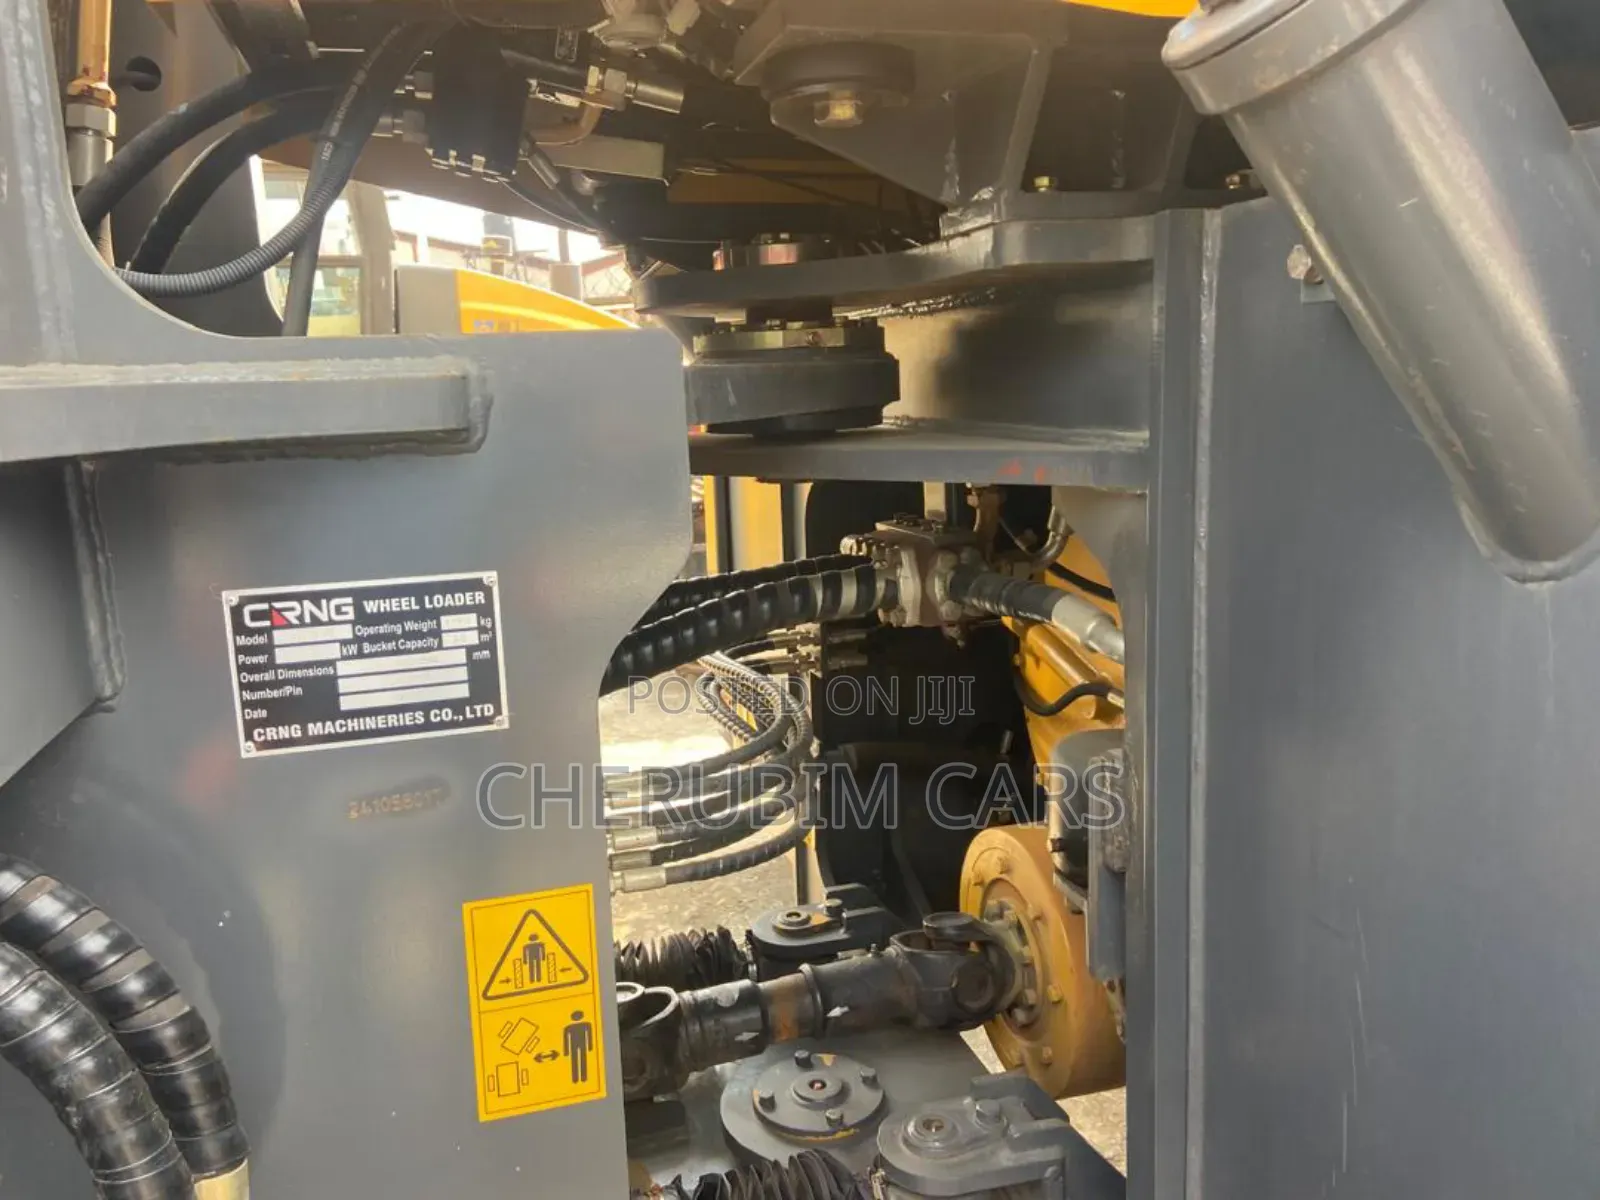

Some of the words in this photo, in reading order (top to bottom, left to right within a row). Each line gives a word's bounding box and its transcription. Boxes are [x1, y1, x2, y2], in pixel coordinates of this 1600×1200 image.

[243, 597, 355, 628] CRNG
[363, 596, 420, 614] WHEEL
[424, 591, 486, 609] LOADER
[236, 634, 268, 646] Model
[355, 623, 402, 638] Operating
[404, 619, 437, 632] Weight
[479, 616, 493, 628] kg
[238, 654, 269, 666] Power
[341, 643, 358, 656] kW
[363, 641, 396, 654] Bucket
[398, 637, 439, 651] Capacity
[240, 669, 275, 683] Overall
[277, 665, 334, 680] Dimensions
[472, 650, 491, 660] mm
[244, 708, 268, 720] Date
[253, 724, 302, 742] CRNG
[307, 711, 425, 736] MACHINERIES
